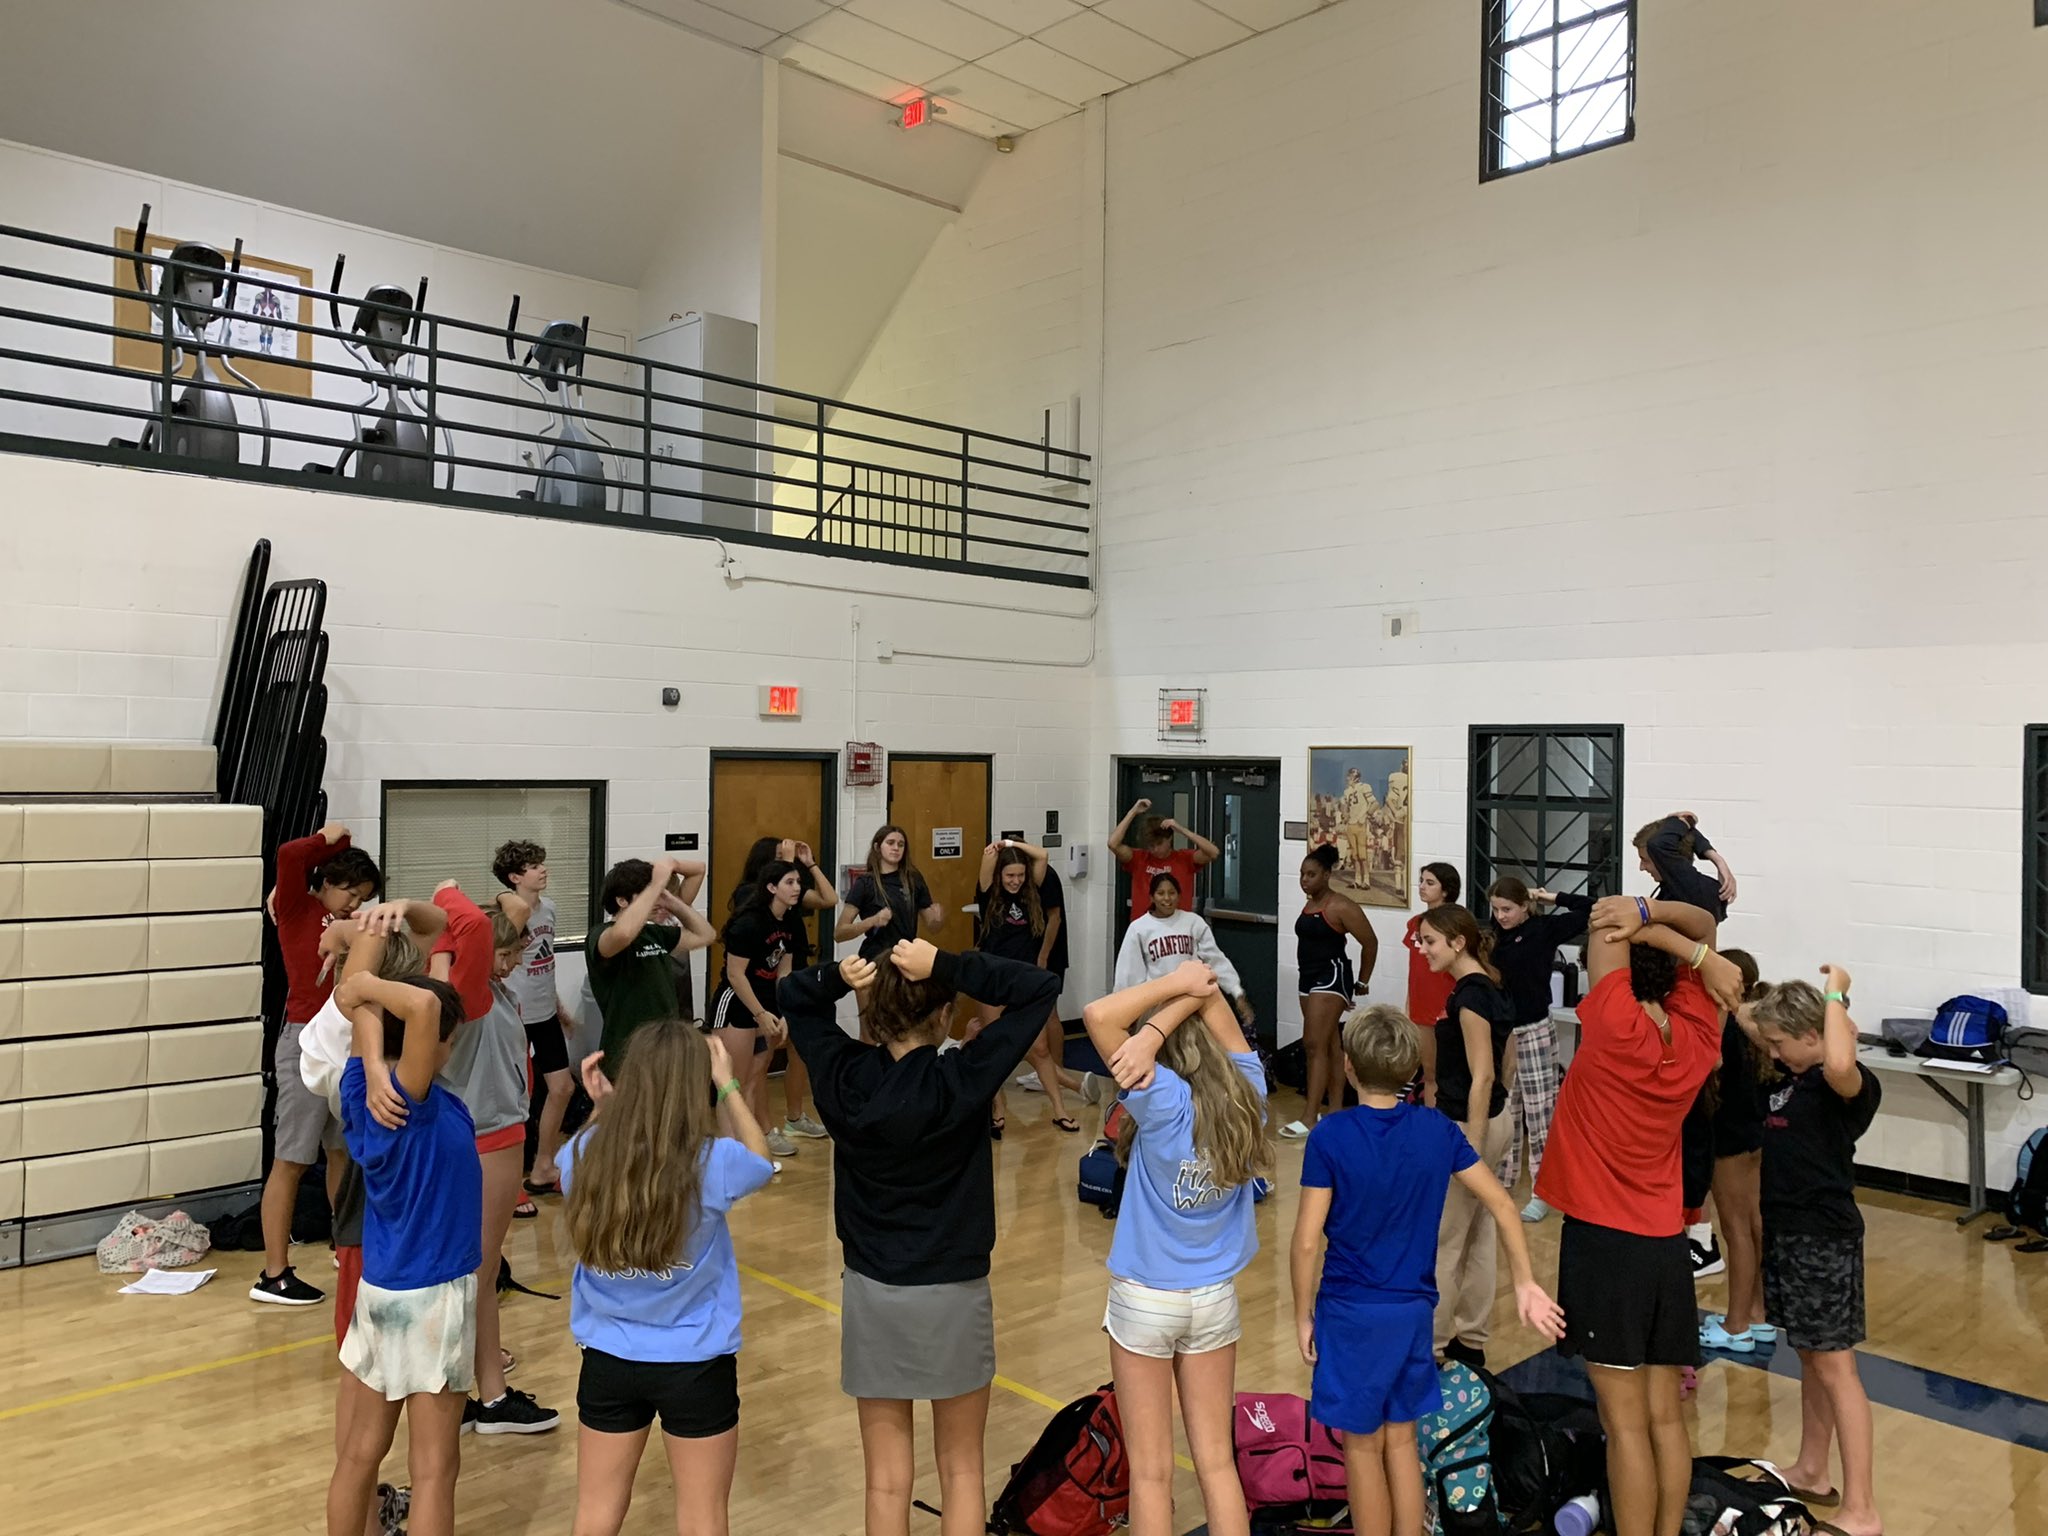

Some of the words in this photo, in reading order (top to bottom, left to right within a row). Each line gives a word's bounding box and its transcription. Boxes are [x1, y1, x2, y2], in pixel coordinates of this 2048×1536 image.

[904, 101, 925, 128] EXIT
[769, 687, 798, 713] EXIT
[1148, 935, 1195, 962] STANFORD
[1253, 1401, 1276, 1433] speedo
